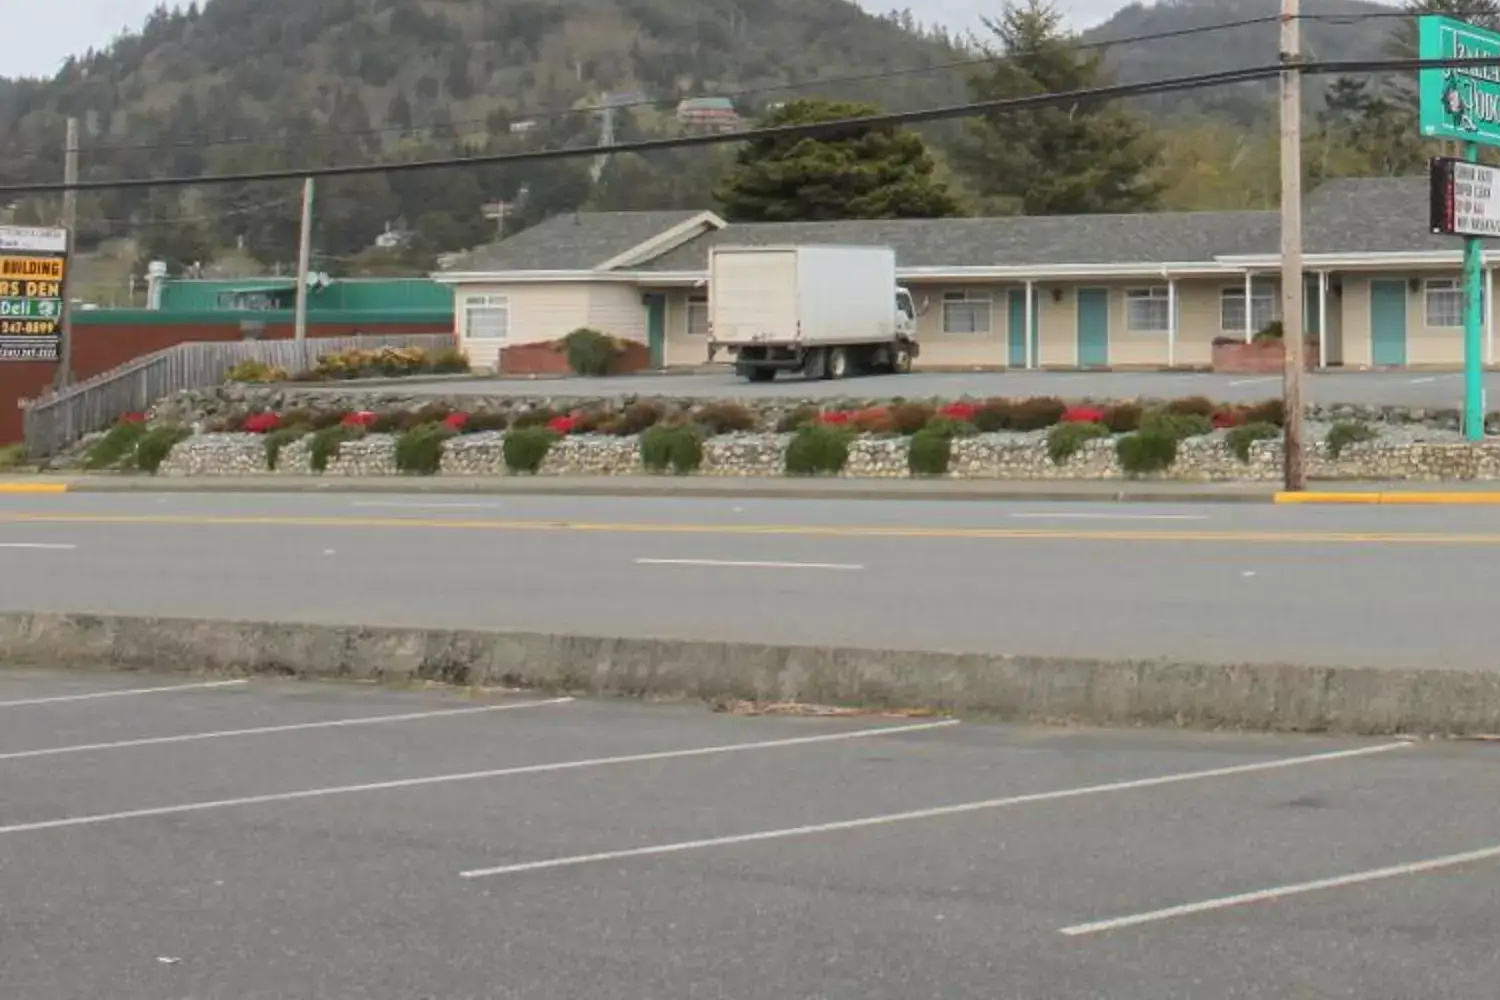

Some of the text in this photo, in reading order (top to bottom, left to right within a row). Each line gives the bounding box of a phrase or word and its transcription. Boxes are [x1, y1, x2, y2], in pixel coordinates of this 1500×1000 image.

[2, 259, 59, 276] BUILDING
[26, 281, 59, 297] DEN
[1, 301, 30, 315] Deli
